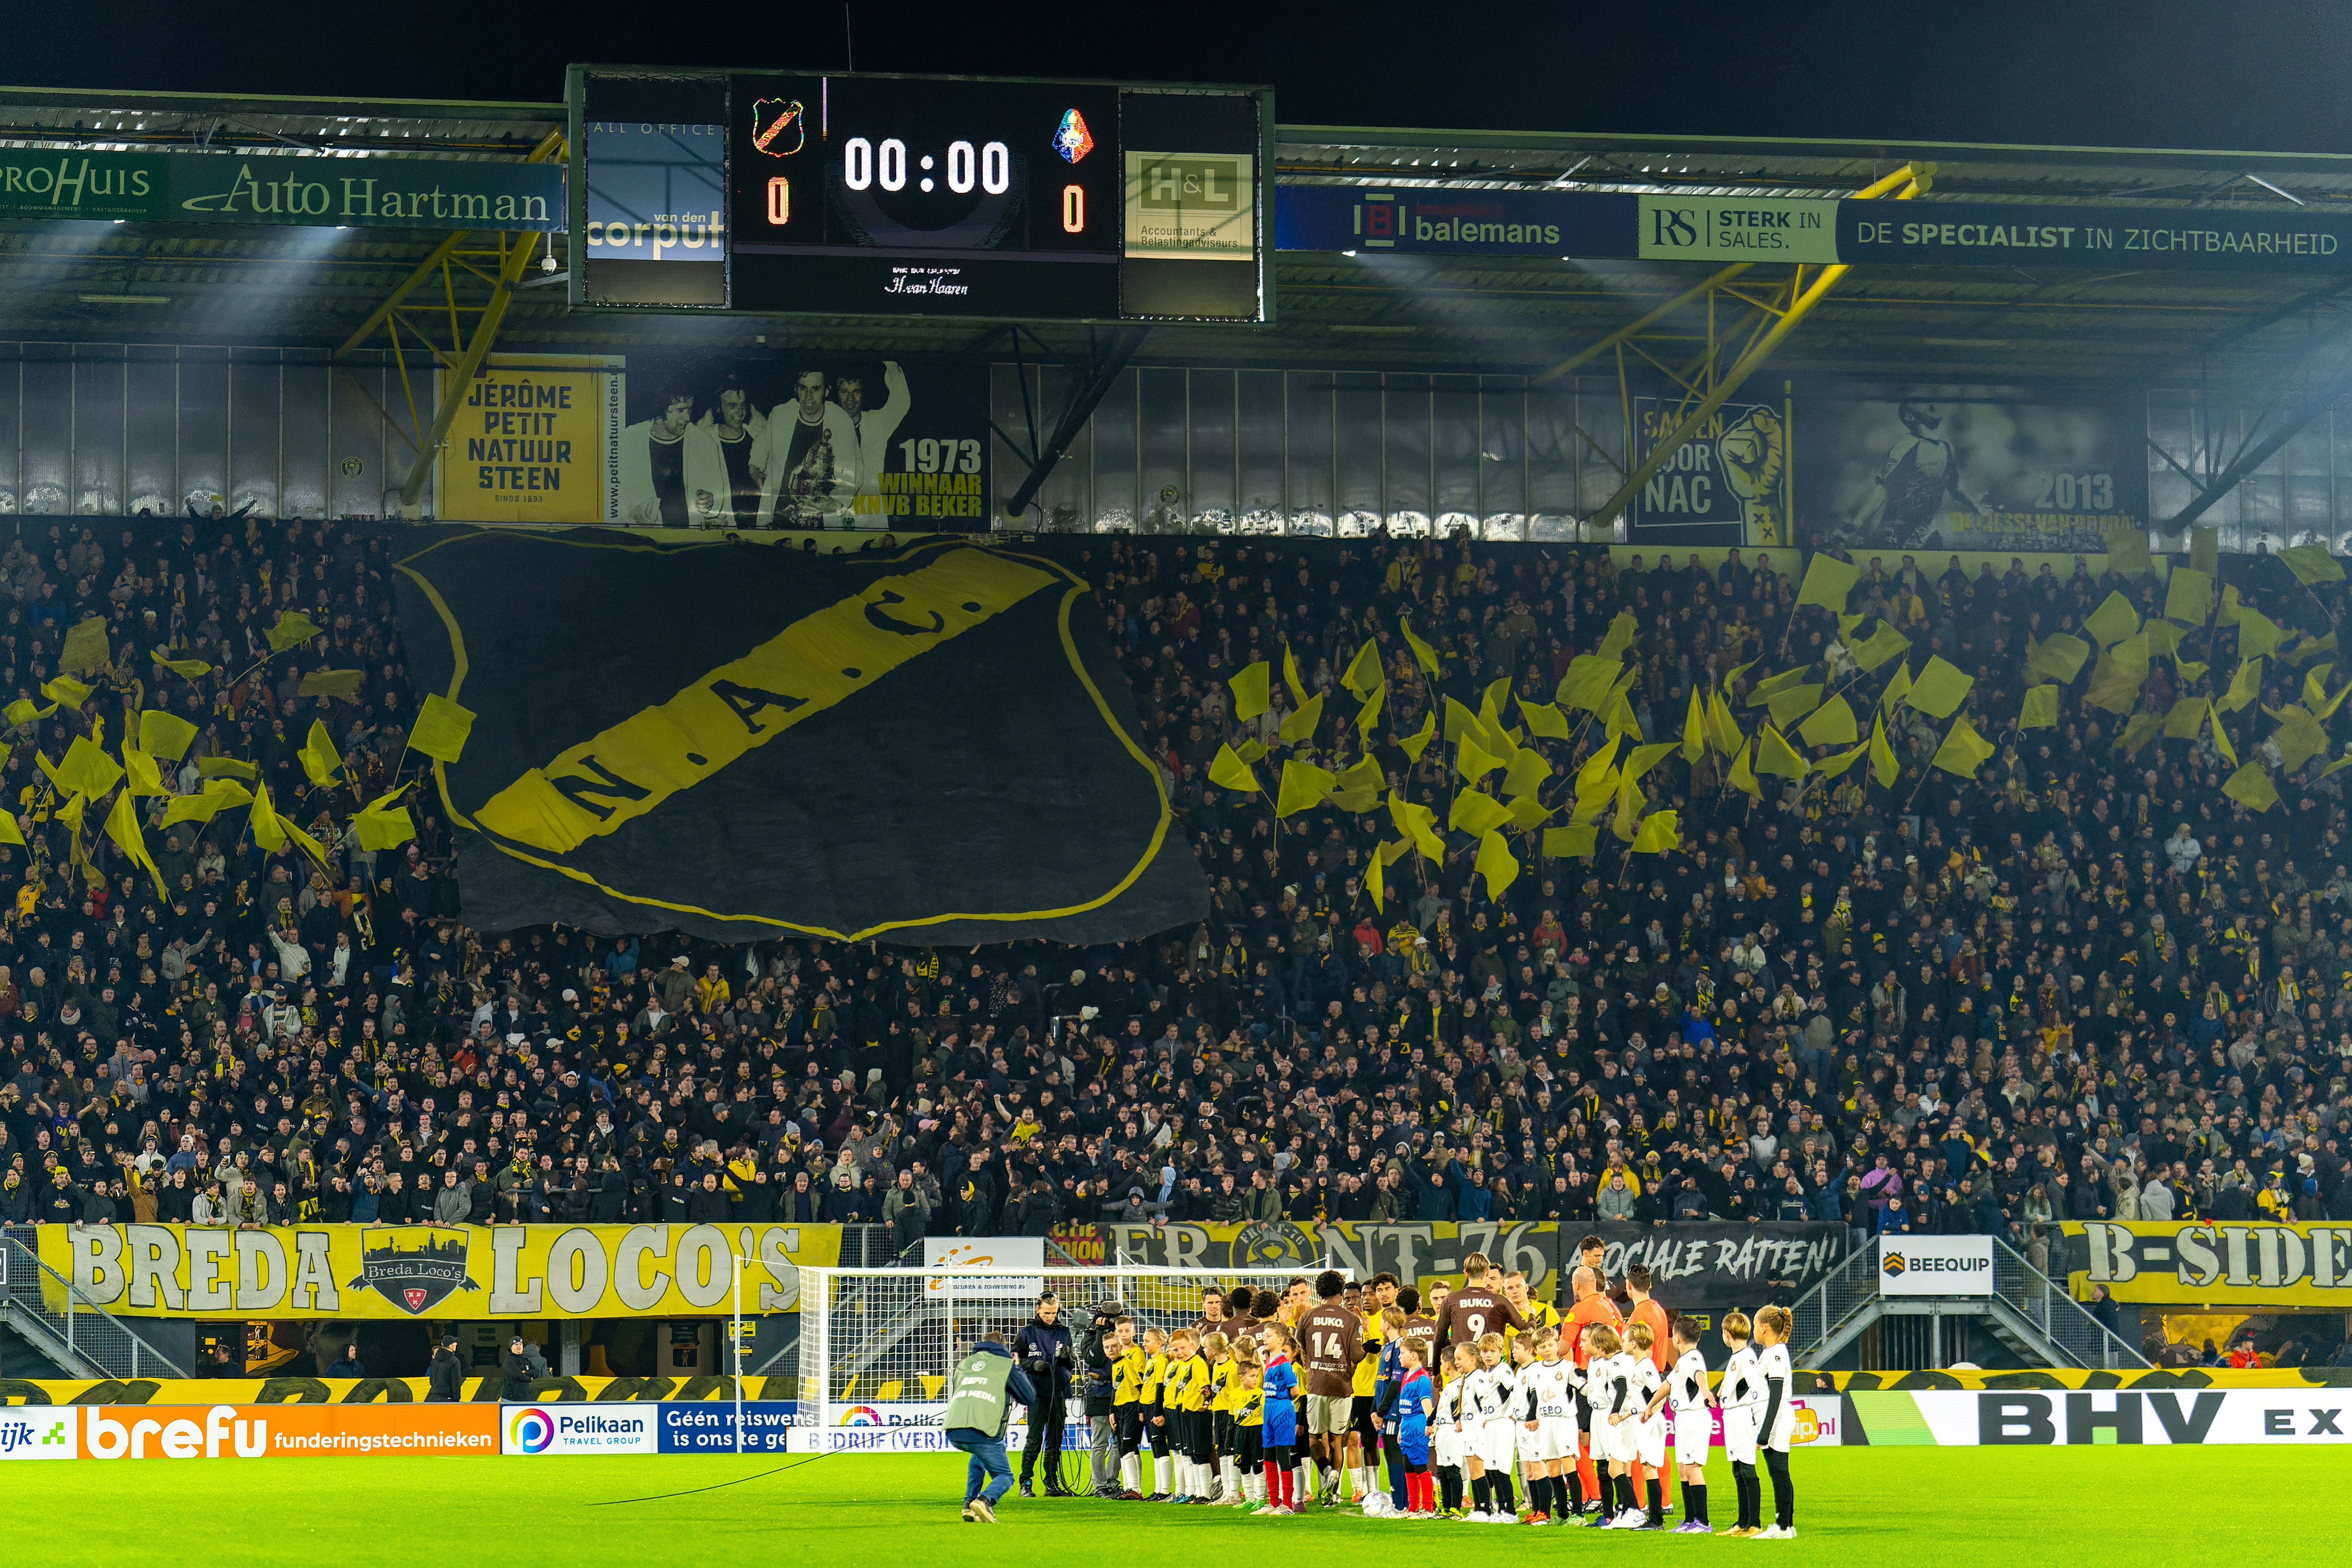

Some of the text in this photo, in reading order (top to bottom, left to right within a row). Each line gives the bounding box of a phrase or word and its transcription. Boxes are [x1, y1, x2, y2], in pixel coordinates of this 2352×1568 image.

[594, 122, 715, 135] ALL OFFICE
[845, 137, 1009, 194] 00:00
[0, 158, 150, 205] ROHUIS
[182, 163, 550, 222] Auto Hartman
[1151, 167, 1228, 202] H&L
[767, 177, 789, 225] 0
[1063, 185, 1084, 233] 0
[654, 212, 705, 223] van den
[1416, 216, 1560, 244] balemans
[1652, 208, 1696, 246] RS
[1719, 209, 1821, 229] STERK IN
[587, 211, 724, 260] corput
[1141, 226, 1216, 236] Accountants &
[1141, 237, 1237, 248] Belastingadviseurs
[1718, 231, 1789, 249] SALES.
[1858, 222, 2337, 255] DE SPECIALIST IN ZICHTBAARHEID
[468, 378, 571, 409] JÉRÔME
[485, 411, 557, 436] PETIT
[468, 438, 571, 464] NATUUR
[899, 438, 981, 473] 1973
[479, 466, 560, 490] STEEN
[878, 472, 982, 495] WINNAAR
[1645, 475, 1711, 514] NAC
[2035, 472, 2113, 510] 2013
[853, 494, 982, 517] KNVB BEKER
[1714, 1233, 1838, 1282] RATTEN!
[1910, 1258, 1989, 1274] BEEQUIP
[2082, 1222, 2352, 1287] B-SIDE
[68, 1223, 800, 1313] BREDA LOCO'S
[368, 1264, 462, 1279] Breda Loco's
[1459, 1298, 1493, 1308] BUKO.
[1313, 1317, 1344, 1328] BUKO.
[1407, 1326, 1434, 1337] UKO.
[1467, 1313, 1485, 1342] 9
[1312, 1332, 1342, 1359] 14
[961, 1377, 988, 1385] ESPN
[968, 1390, 996, 1404] MEDIA
[667, 1411, 815, 1426] Géén reiswens
[1539, 1406, 1562, 1416] CEBO
[1978, 1393, 2344, 1444] BHV EX
[86, 1405, 267, 1459] brefu
[560, 1415, 643, 1434] Pelikaan
[1793, 1417, 1835, 1439] ip.nl
[1, 1423, 35, 1452] ijk
[275, 1431, 492, 1452] funderingstechnieken
[608, 1436, 641, 1444] GROUP
[673, 1431, 689, 1446] is
[696, 1435, 732, 1446] ons
[740, 1432, 758, 1446] te
